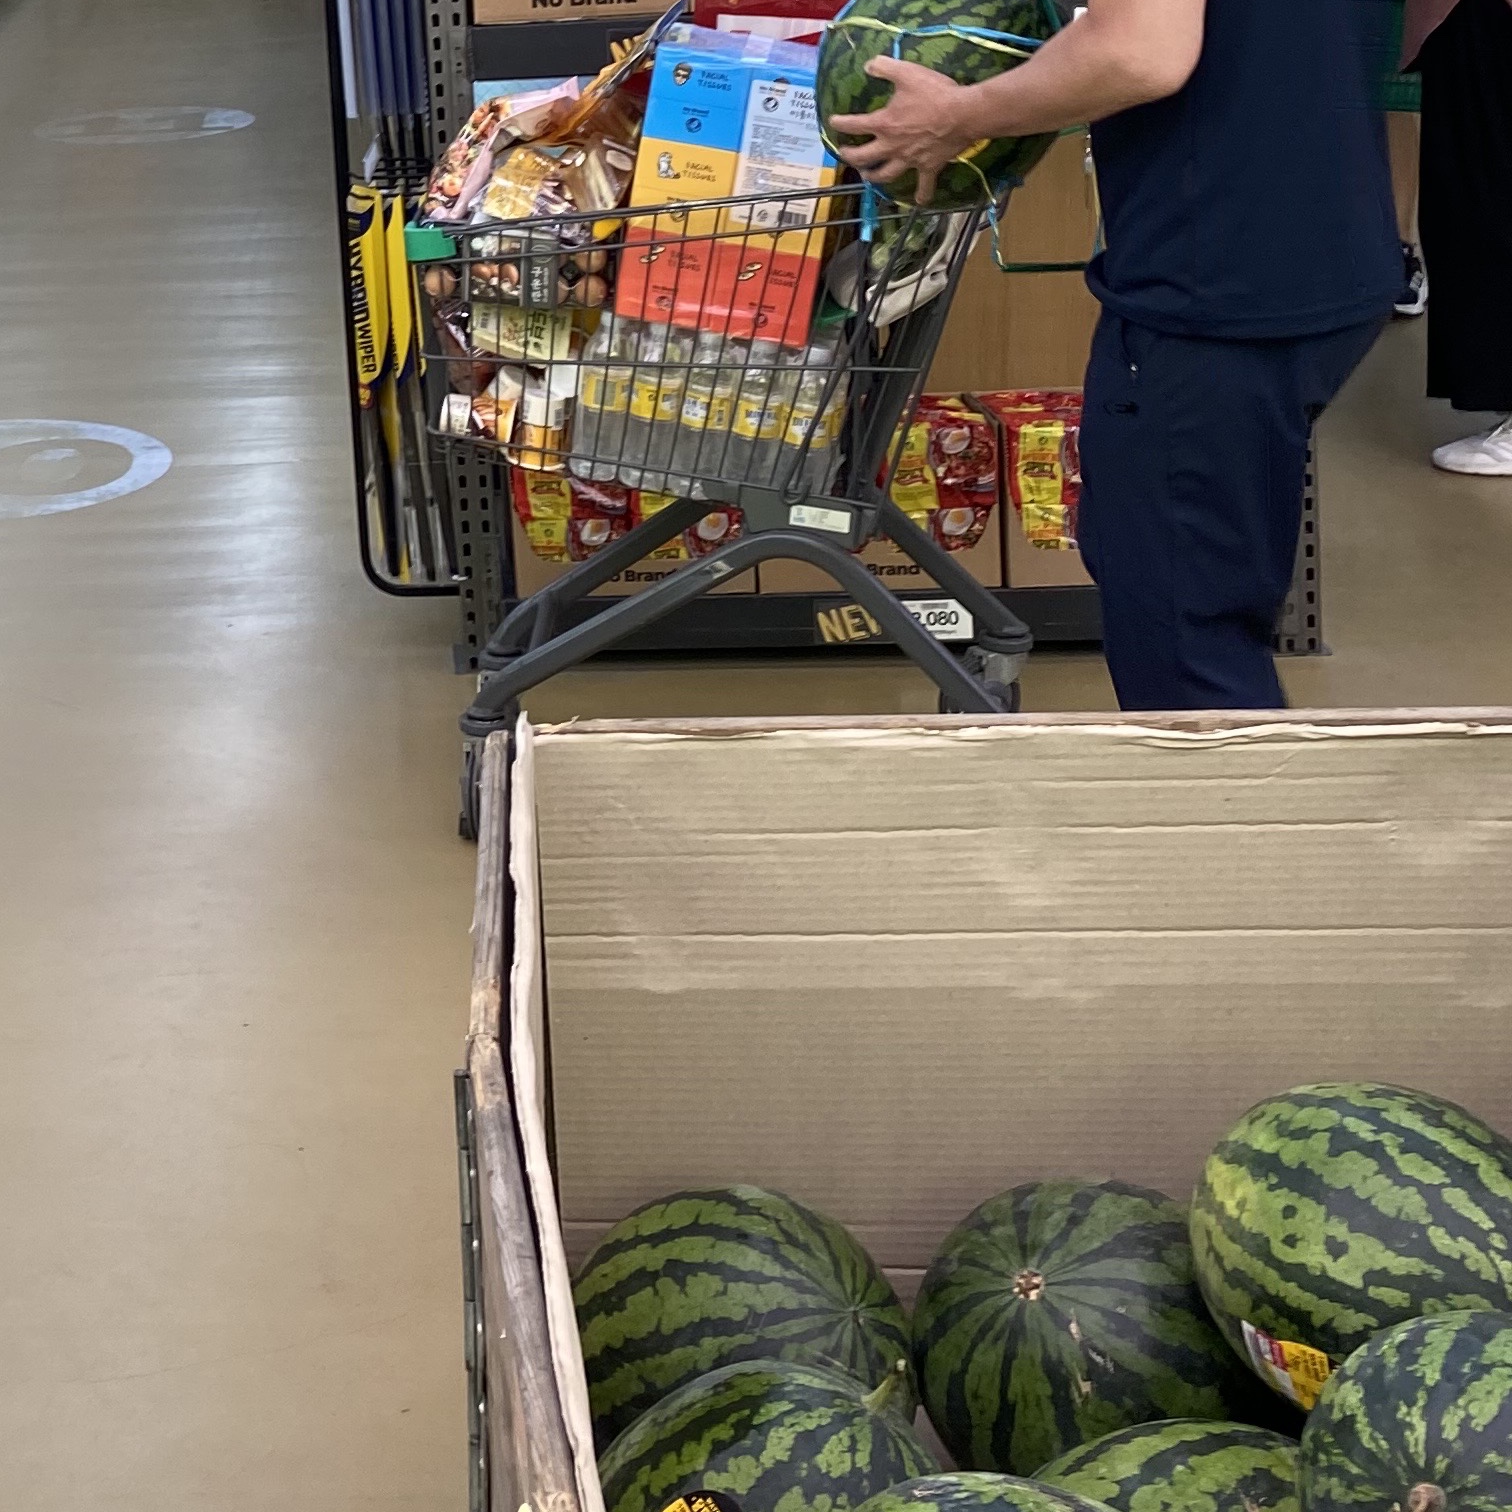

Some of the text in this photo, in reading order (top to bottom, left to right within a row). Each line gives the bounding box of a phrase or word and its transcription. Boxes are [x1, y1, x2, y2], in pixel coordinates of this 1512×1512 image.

[794, 91, 814, 101] FACI
[790, 99, 816, 110] TISSU
[355, 323, 378, 375] WIPER
